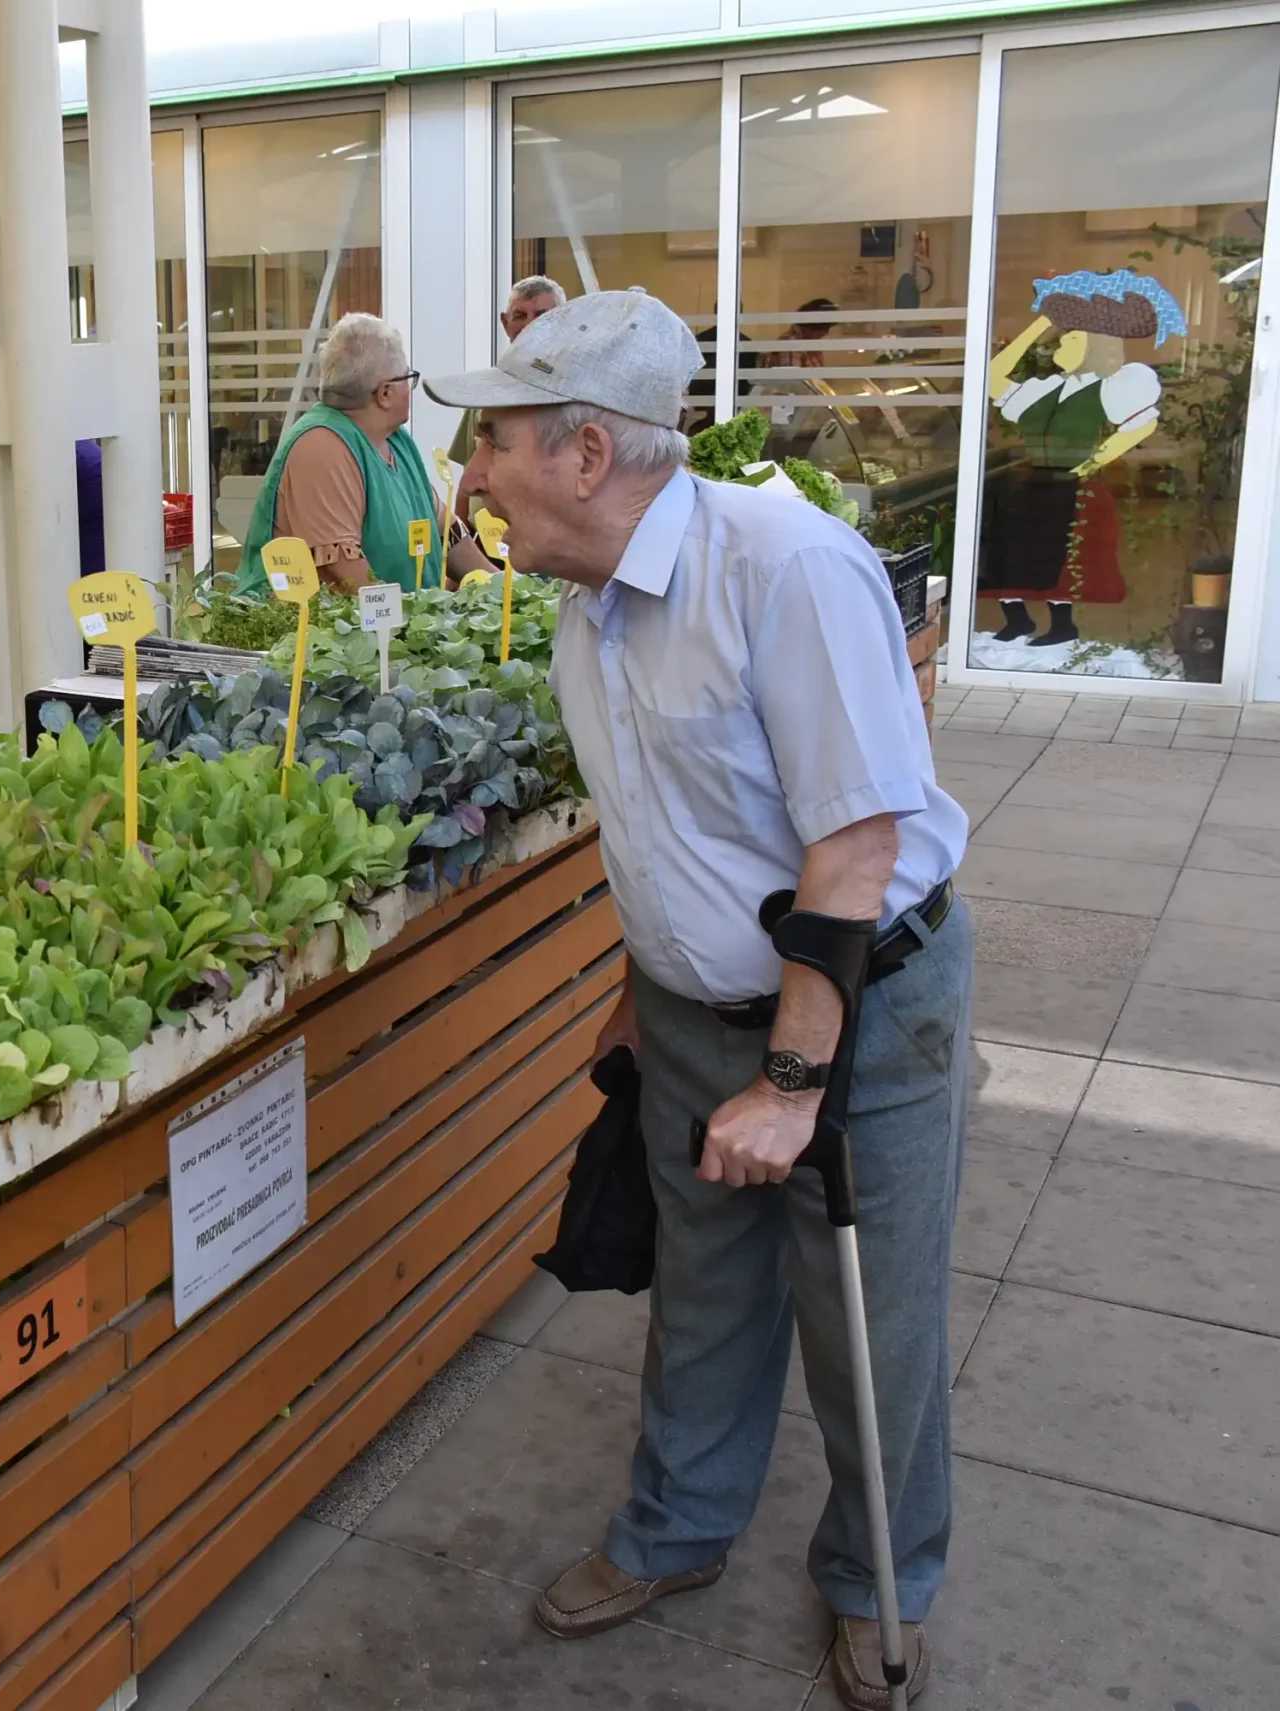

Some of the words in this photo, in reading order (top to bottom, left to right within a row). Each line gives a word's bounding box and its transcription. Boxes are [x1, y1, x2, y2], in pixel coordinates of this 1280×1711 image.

[82, 592, 118, 603] CRVENI
[180, 1156, 197, 1173] OPG
[198, 1132, 233, 1162] PINTARIĆ
[237, 1111, 264, 1138] ZVONKO
[266, 1088, 295, 1115] PINTARIĆ
[17, 1298, 60, 1365] 91
